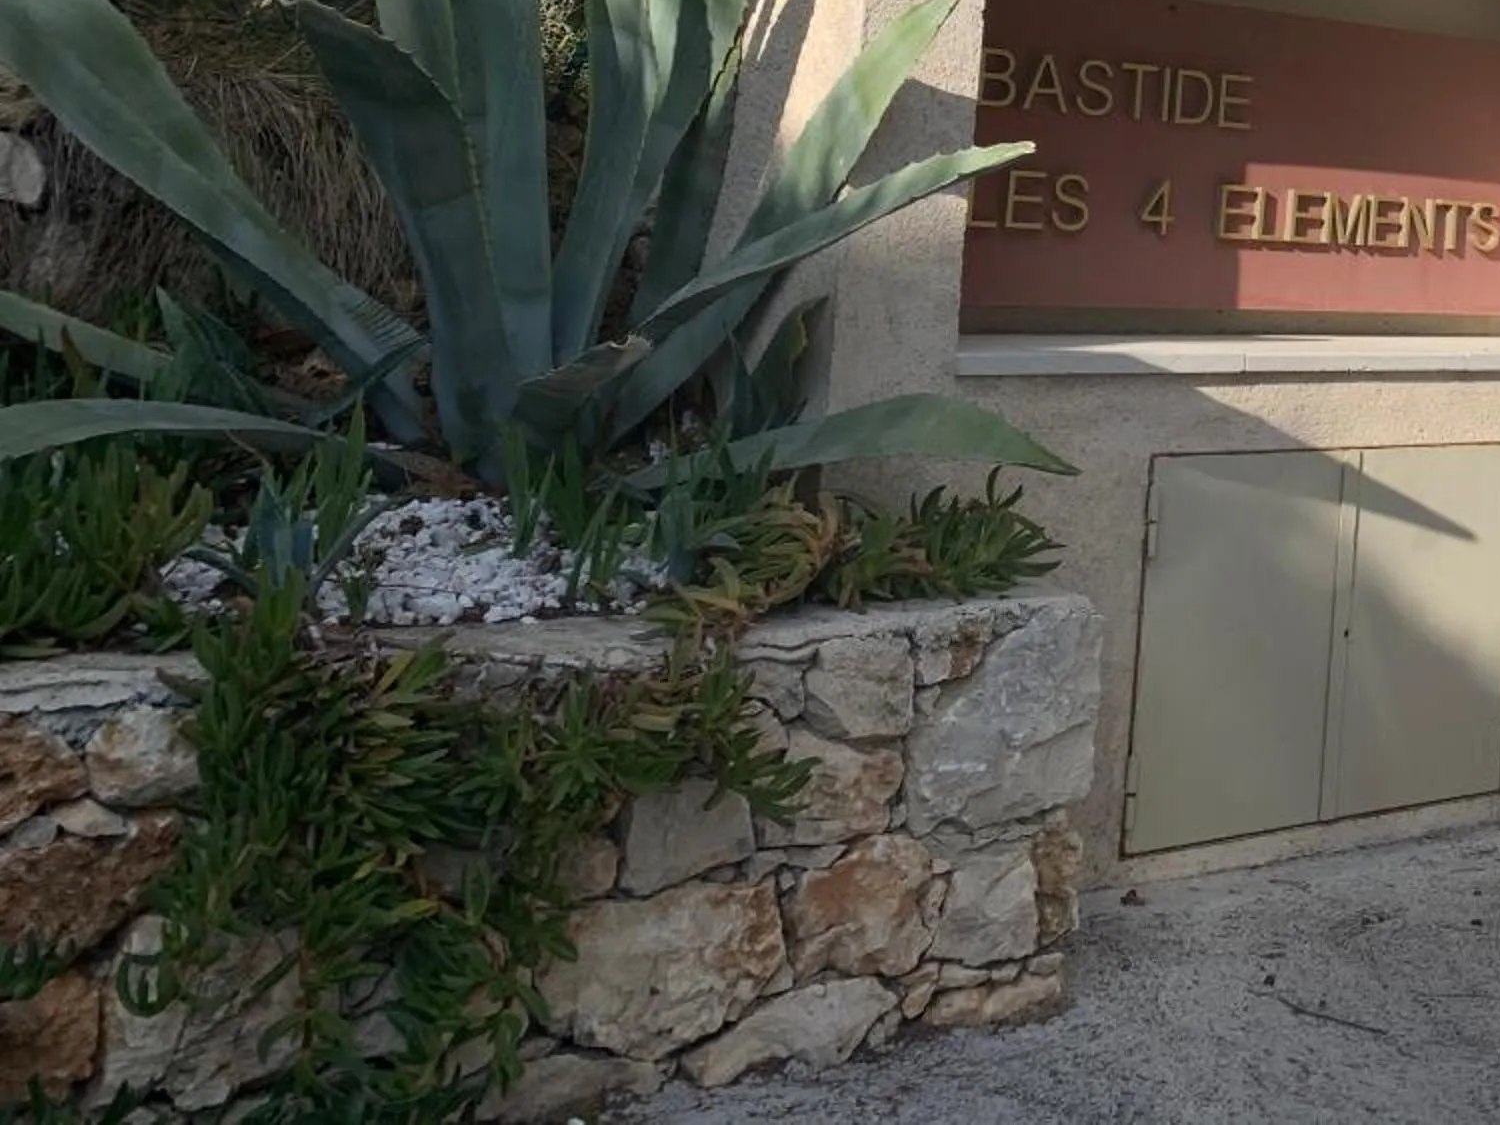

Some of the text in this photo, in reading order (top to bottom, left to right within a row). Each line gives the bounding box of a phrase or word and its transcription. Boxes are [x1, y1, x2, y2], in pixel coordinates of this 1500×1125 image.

[977, 47, 1253, 130] BASTIDE
[968, 170, 1500, 252] LES 4 ELEMENTS
